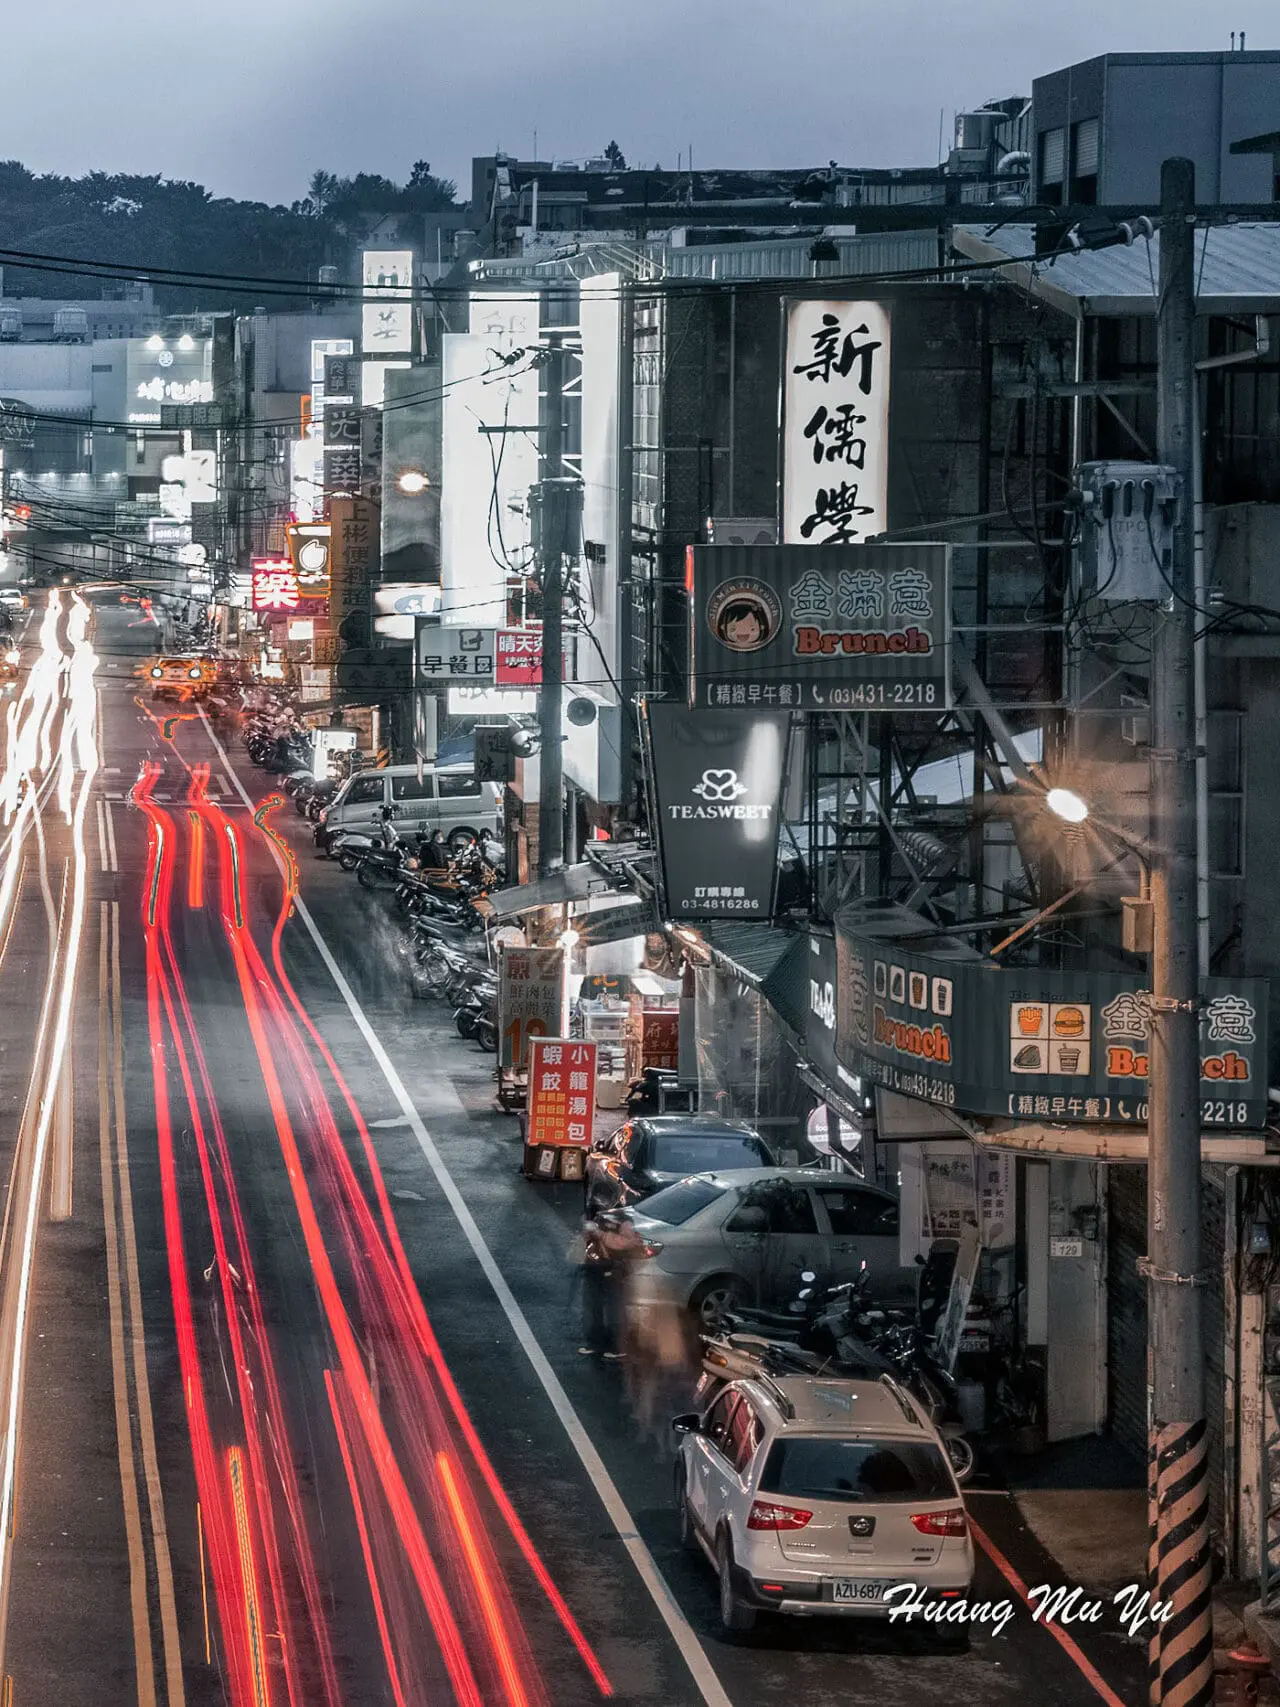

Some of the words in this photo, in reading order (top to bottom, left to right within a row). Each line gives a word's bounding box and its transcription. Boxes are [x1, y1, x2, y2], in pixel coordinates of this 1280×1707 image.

[793, 314, 882, 544] 新儒學
[254, 560, 299, 608] 藥
[790, 568, 933, 618] 金滿意
[794, 625, 933, 656] Brunch
[829, 684, 936, 705] (03)431-2218
[668, 805, 772, 819] TEASWEET
[682, 900, 759, 909] 03-4816286
[1102, 993, 1255, 1042] 金意
[541, 1046, 562, 1091] 蝦餃
[1106, 1046, 1250, 1081] Brch
[568, 1046, 589, 1140] 小籠湯包
